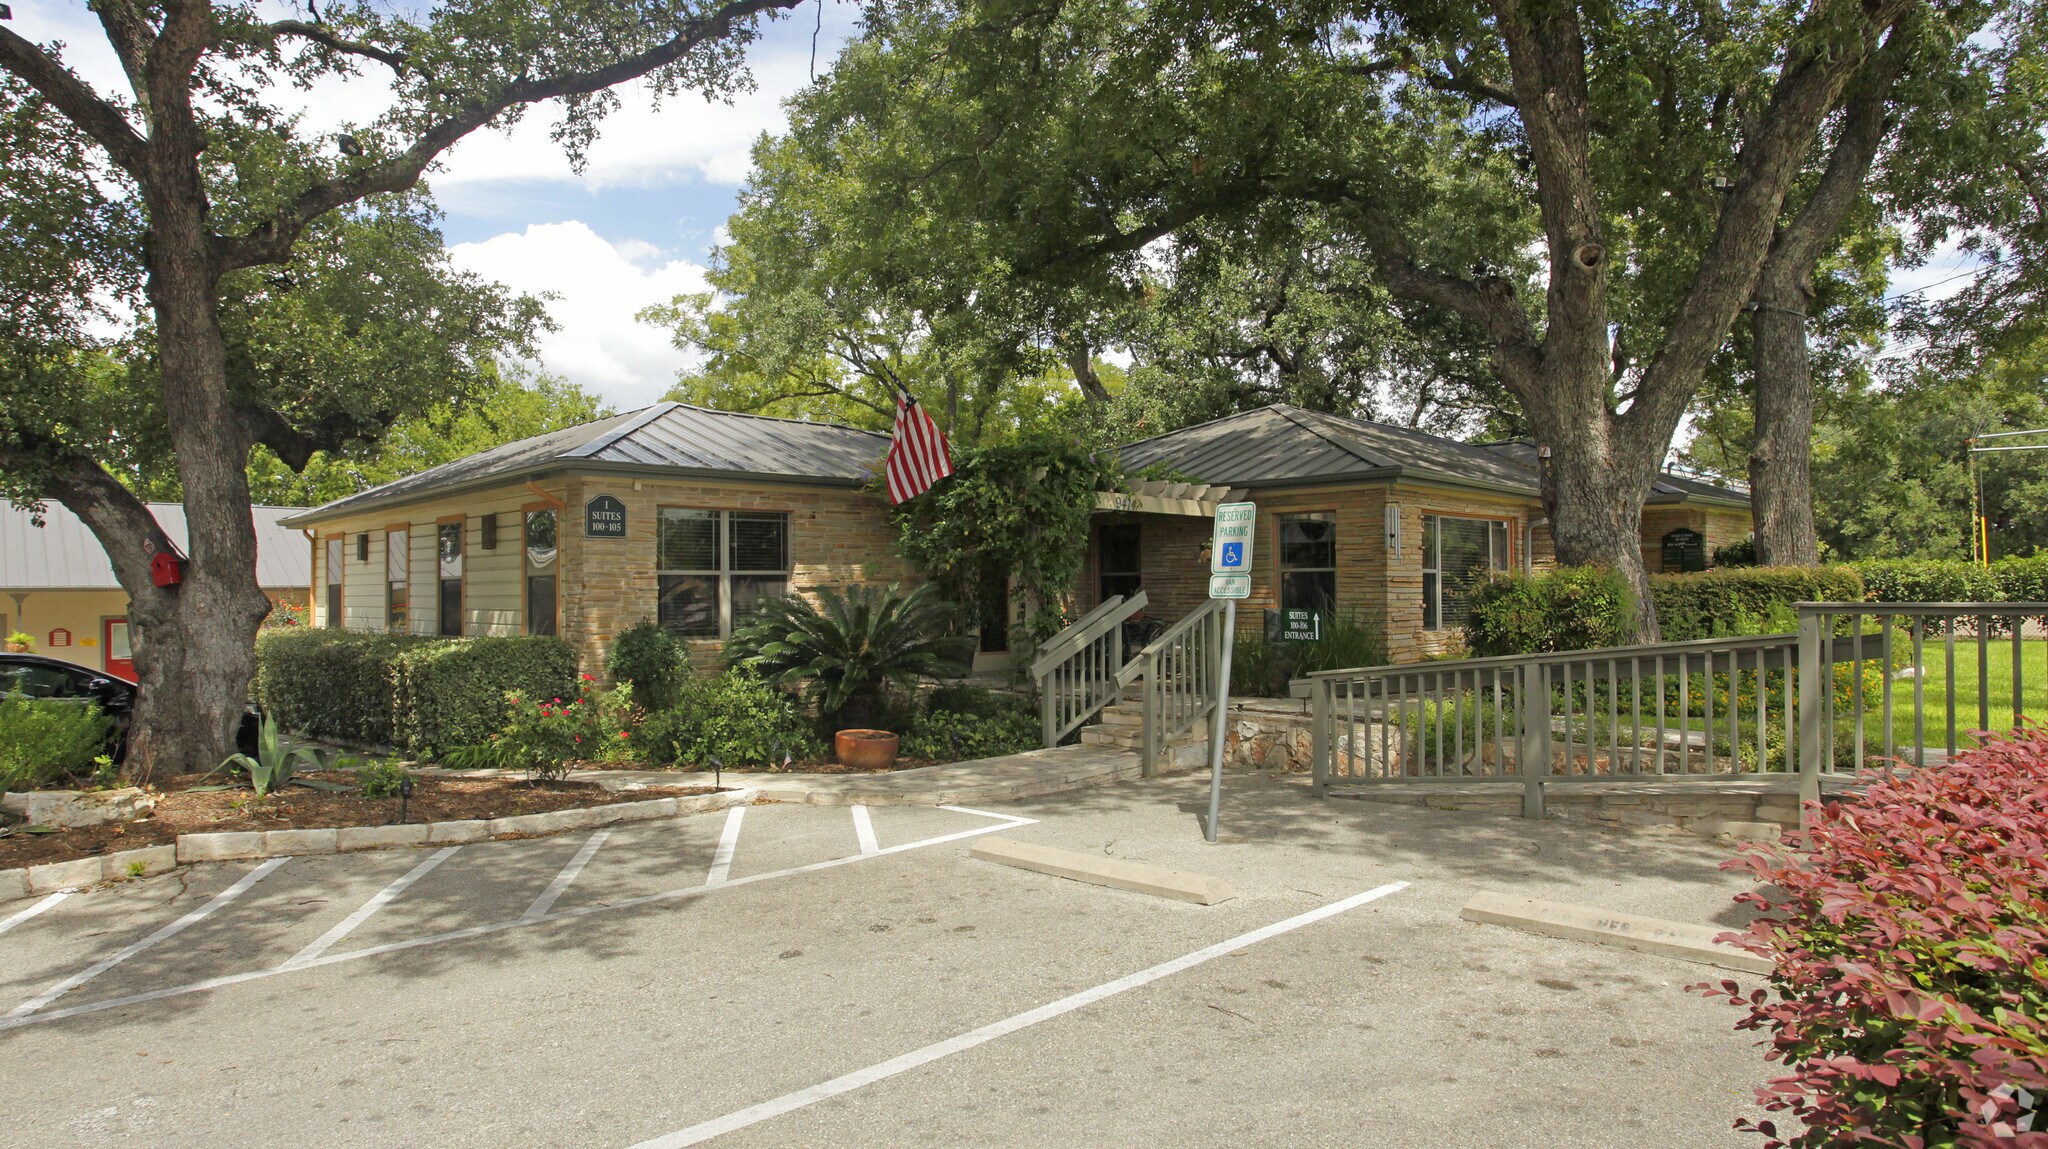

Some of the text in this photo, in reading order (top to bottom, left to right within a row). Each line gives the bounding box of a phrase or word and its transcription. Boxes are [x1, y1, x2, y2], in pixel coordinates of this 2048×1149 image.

[592, 511, 621, 520] SUITES
[1219, 509, 1252, 522] RESERVED
[592, 522, 621, 532] 100-105
[1220, 526, 1248, 537] PARKING
[1214, 586, 1246, 594] ACCESSIBLE
[1288, 611, 1308, 620] SUITES
[1284, 631, 1314, 640] ENTRANCE
